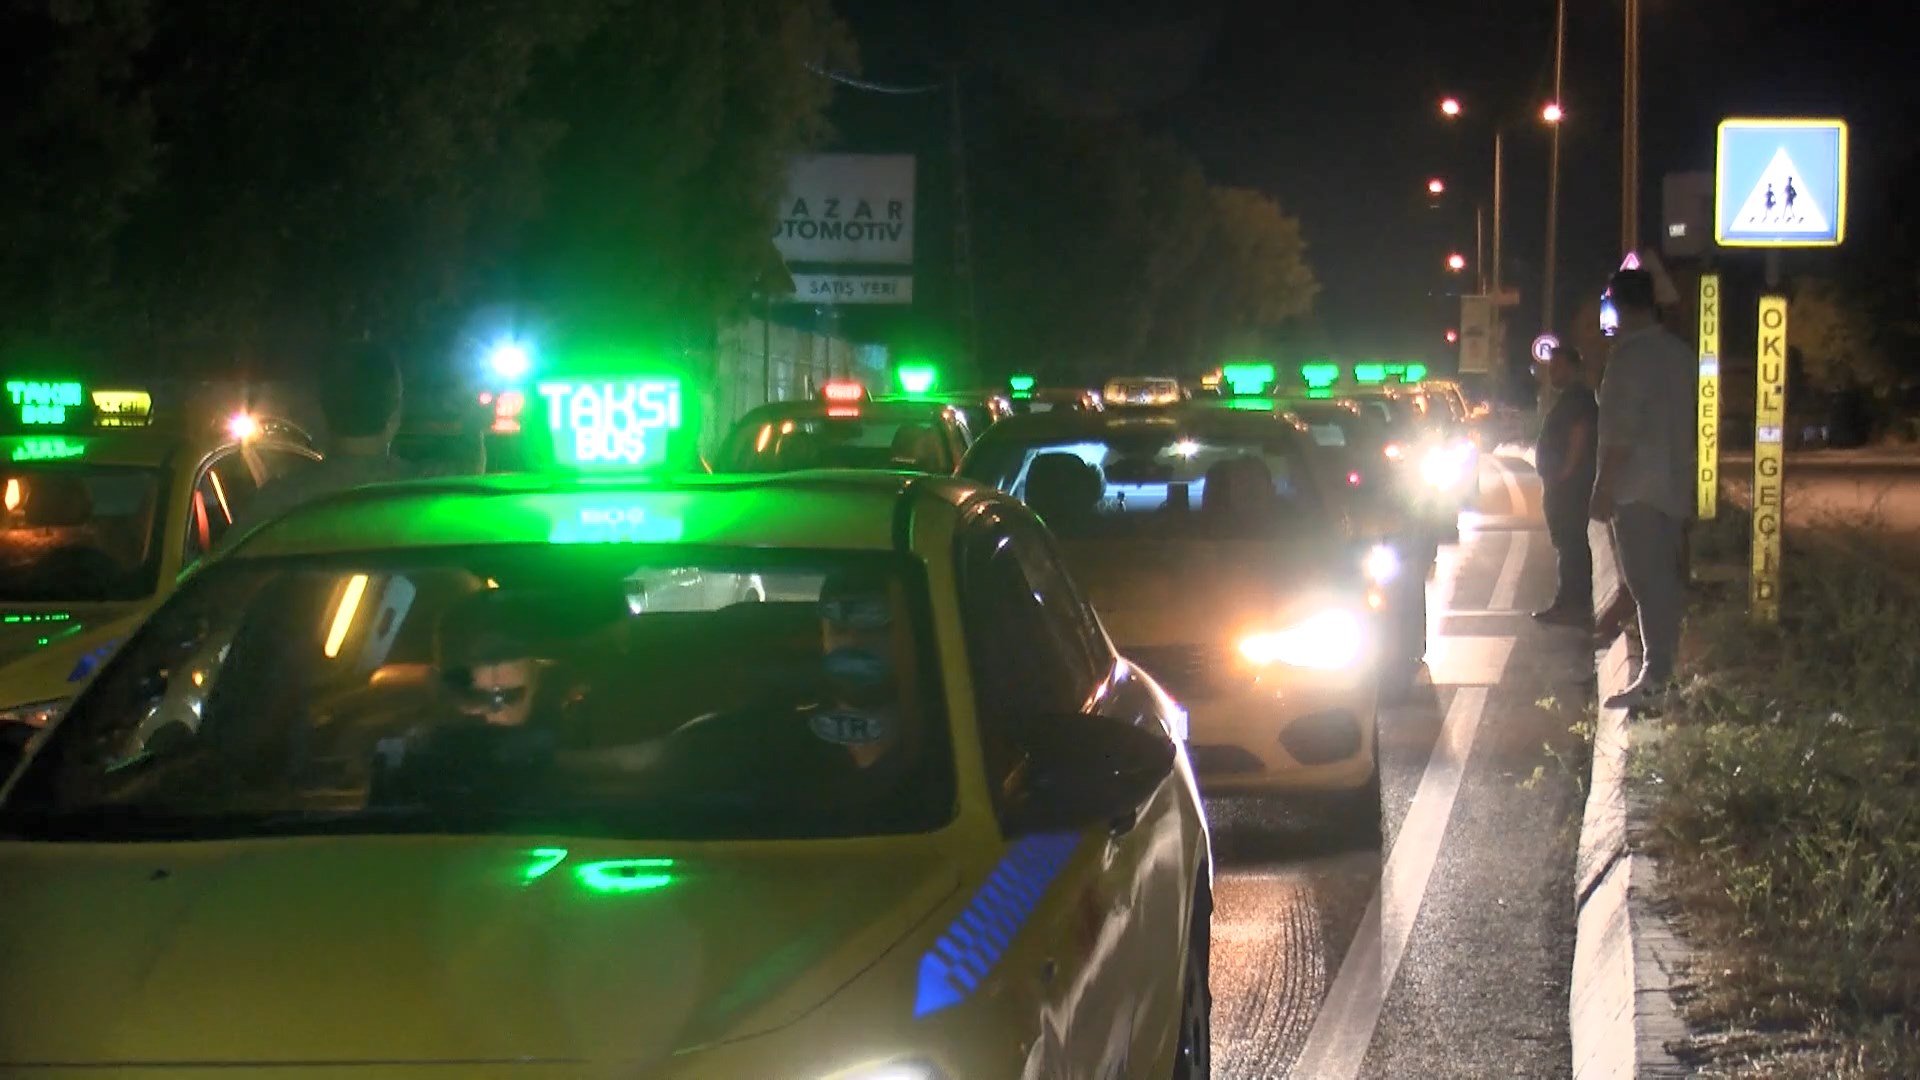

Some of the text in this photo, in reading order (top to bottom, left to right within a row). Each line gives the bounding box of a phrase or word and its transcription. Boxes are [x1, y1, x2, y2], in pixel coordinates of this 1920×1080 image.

[791, 197, 904, 220] AZAR
[1702, 283, 1716, 354] OKUL
[1763, 308, 1783, 411] OKUL
